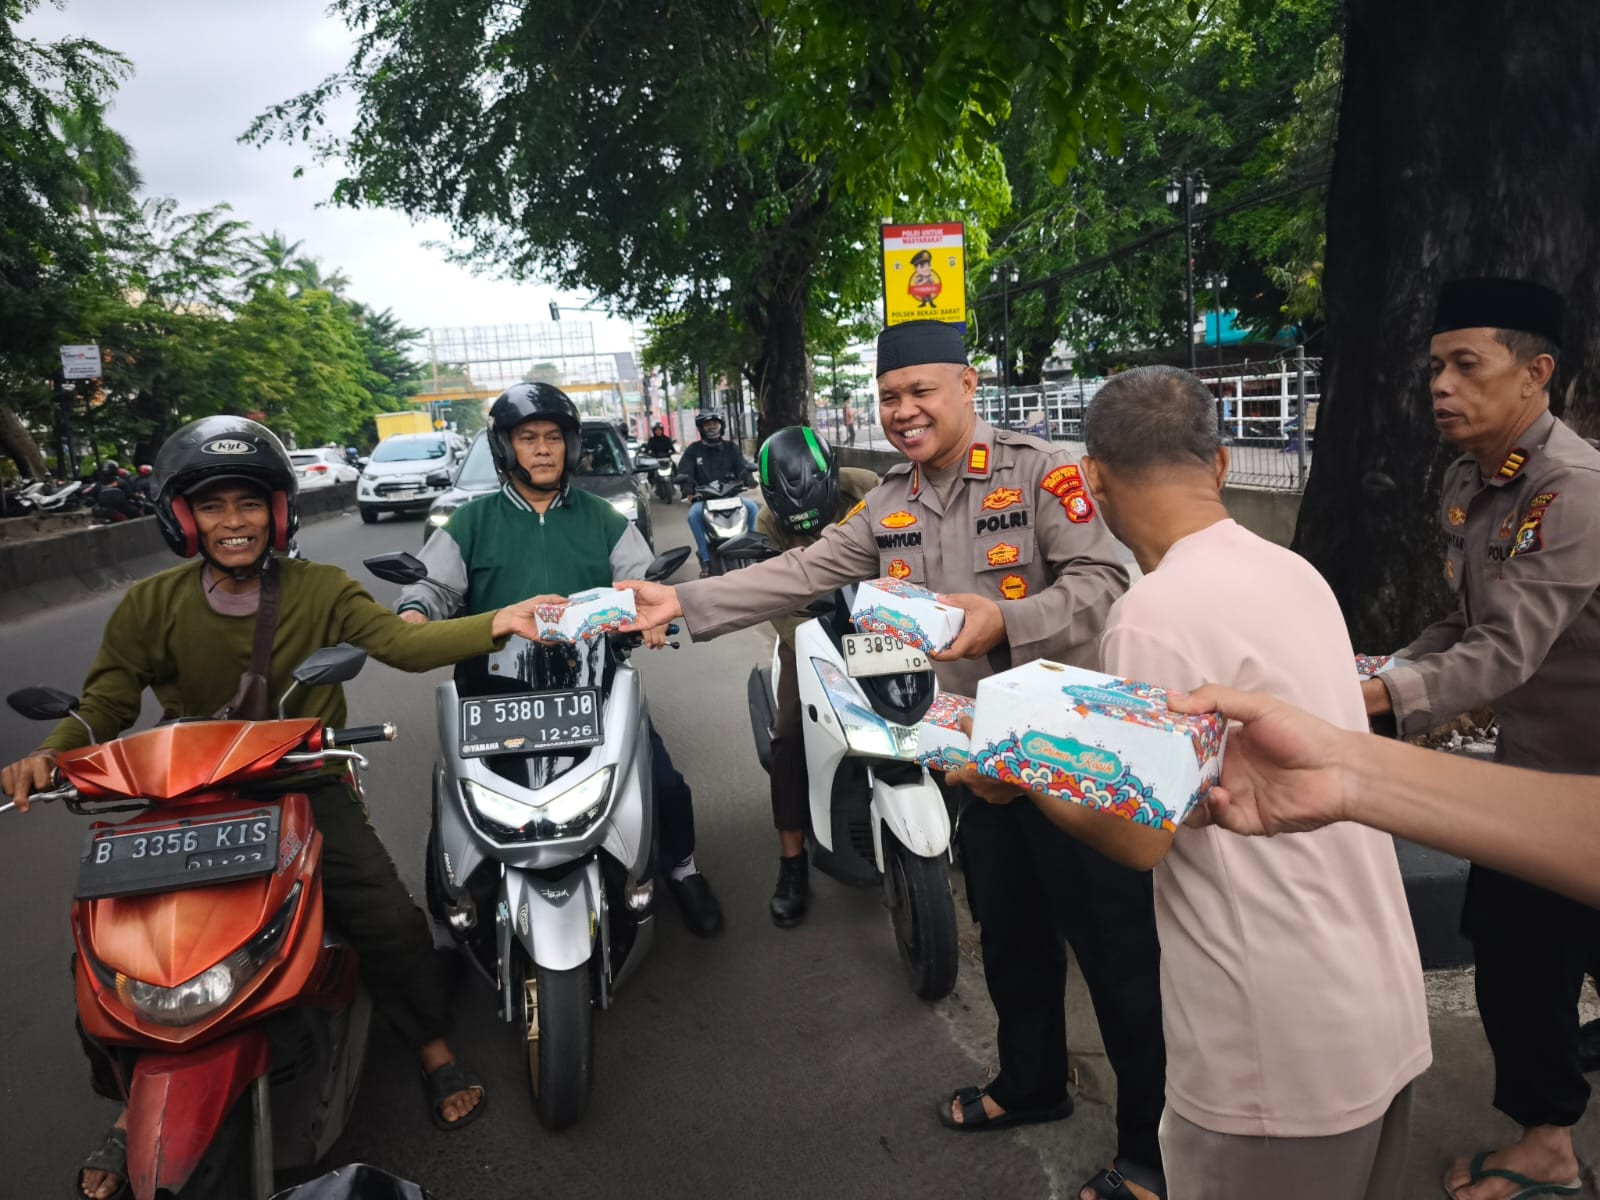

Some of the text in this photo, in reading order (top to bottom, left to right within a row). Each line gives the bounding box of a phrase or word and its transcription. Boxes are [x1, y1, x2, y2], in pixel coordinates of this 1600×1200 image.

[976, 510, 1028, 535] POLRI
[875, 531, 922, 549] WAHYUDI
[846, 638, 856, 656] B
[470, 705, 481, 726] B
[495, 700, 545, 723] 5380
[470, 741, 499, 753] YAMAHA
[95, 842, 112, 864] B
[132, 831, 200, 859] 3356
[216, 822, 267, 848] KIS
